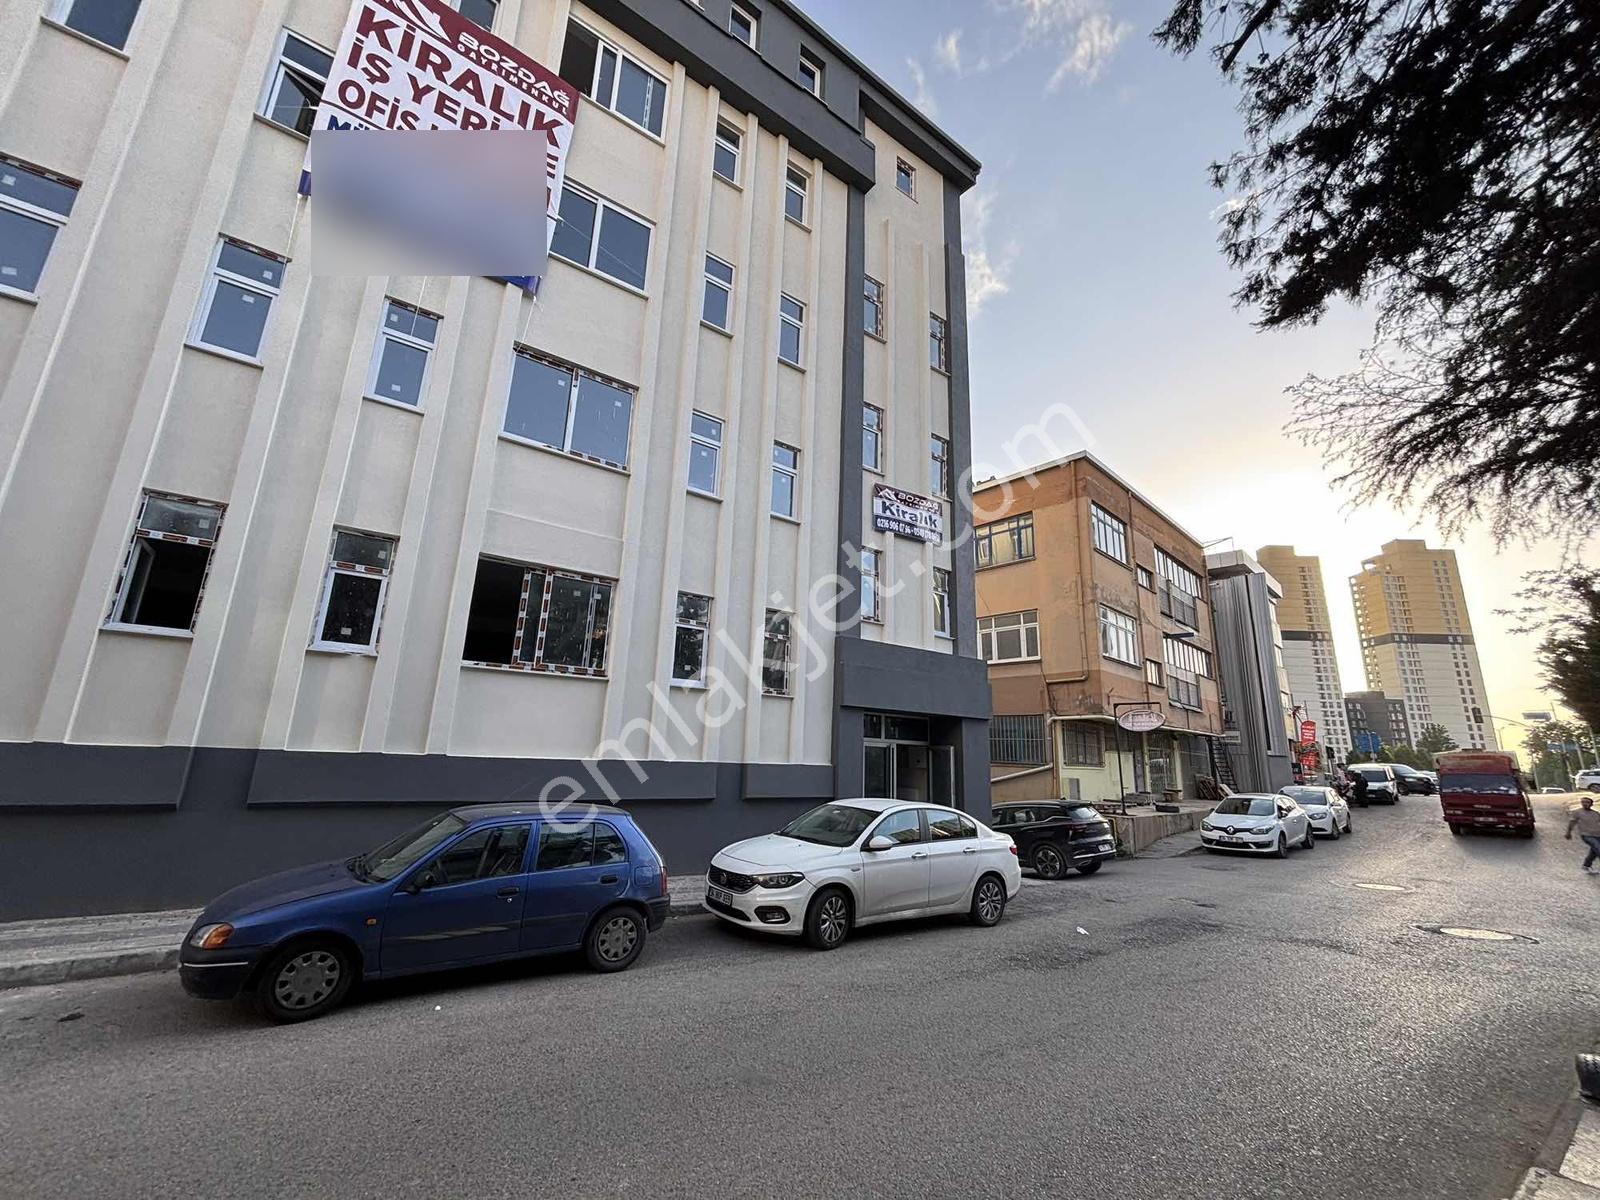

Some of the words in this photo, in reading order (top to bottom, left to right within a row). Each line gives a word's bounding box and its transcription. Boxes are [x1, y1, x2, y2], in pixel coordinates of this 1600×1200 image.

[346, 37, 392, 85] İŞ
[356, 5, 564, 149] KİRALIK
[458, 31, 570, 108] BOZDAĞ
[881, 500, 938, 528] Kiralık
